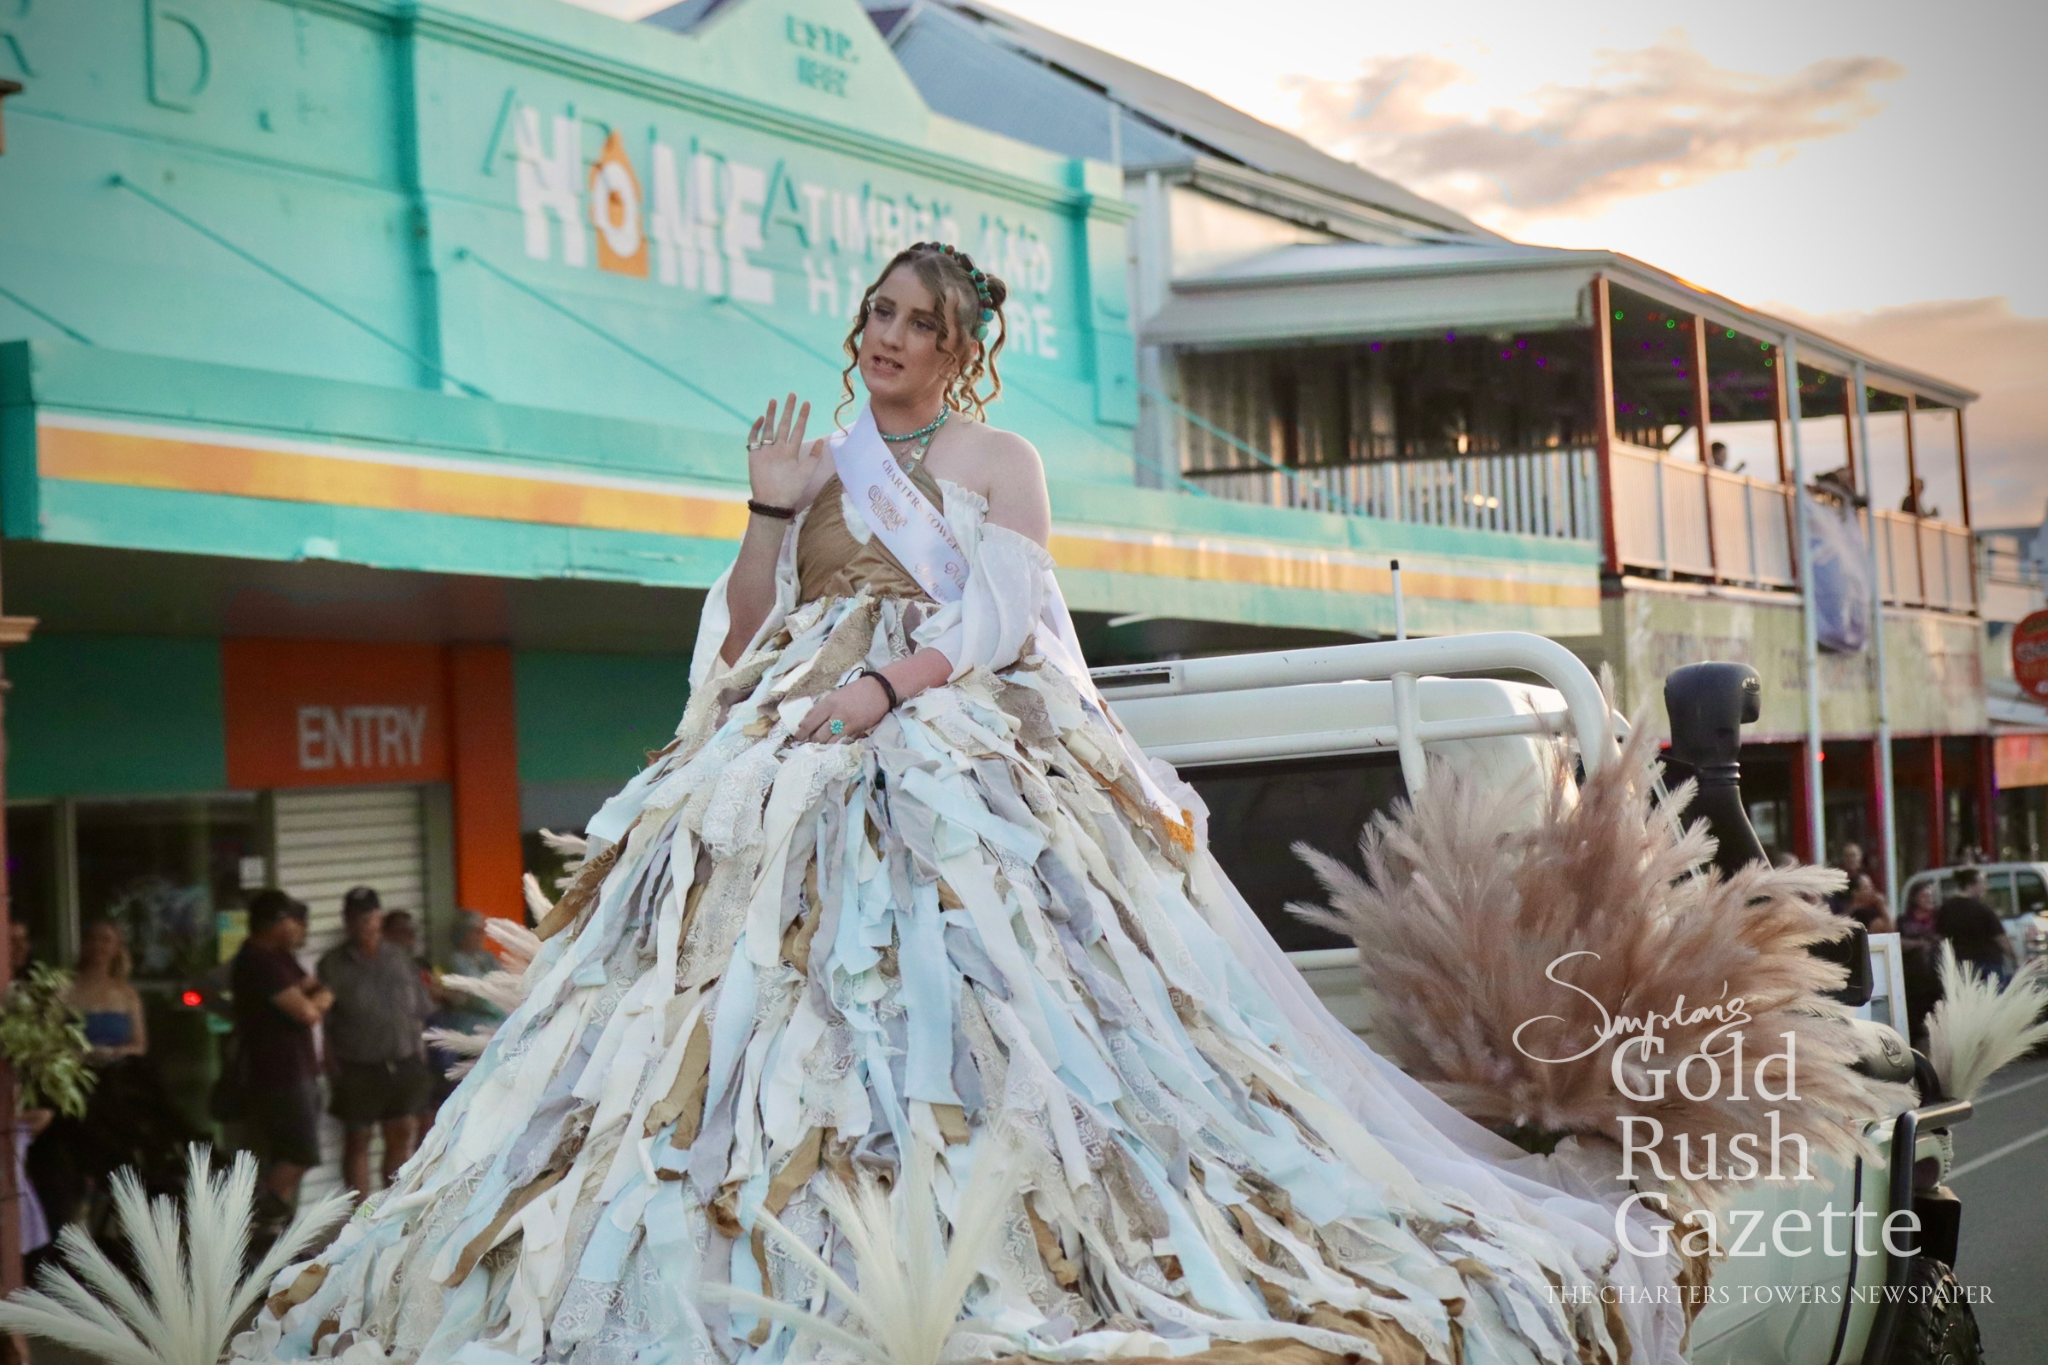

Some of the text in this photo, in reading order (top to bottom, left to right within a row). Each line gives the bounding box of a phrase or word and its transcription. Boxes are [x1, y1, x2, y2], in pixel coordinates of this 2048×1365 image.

[514, 104, 774, 305] HOME
[882, 459, 929, 516] CHARTERS
[299, 705, 428, 770] ENTRY
